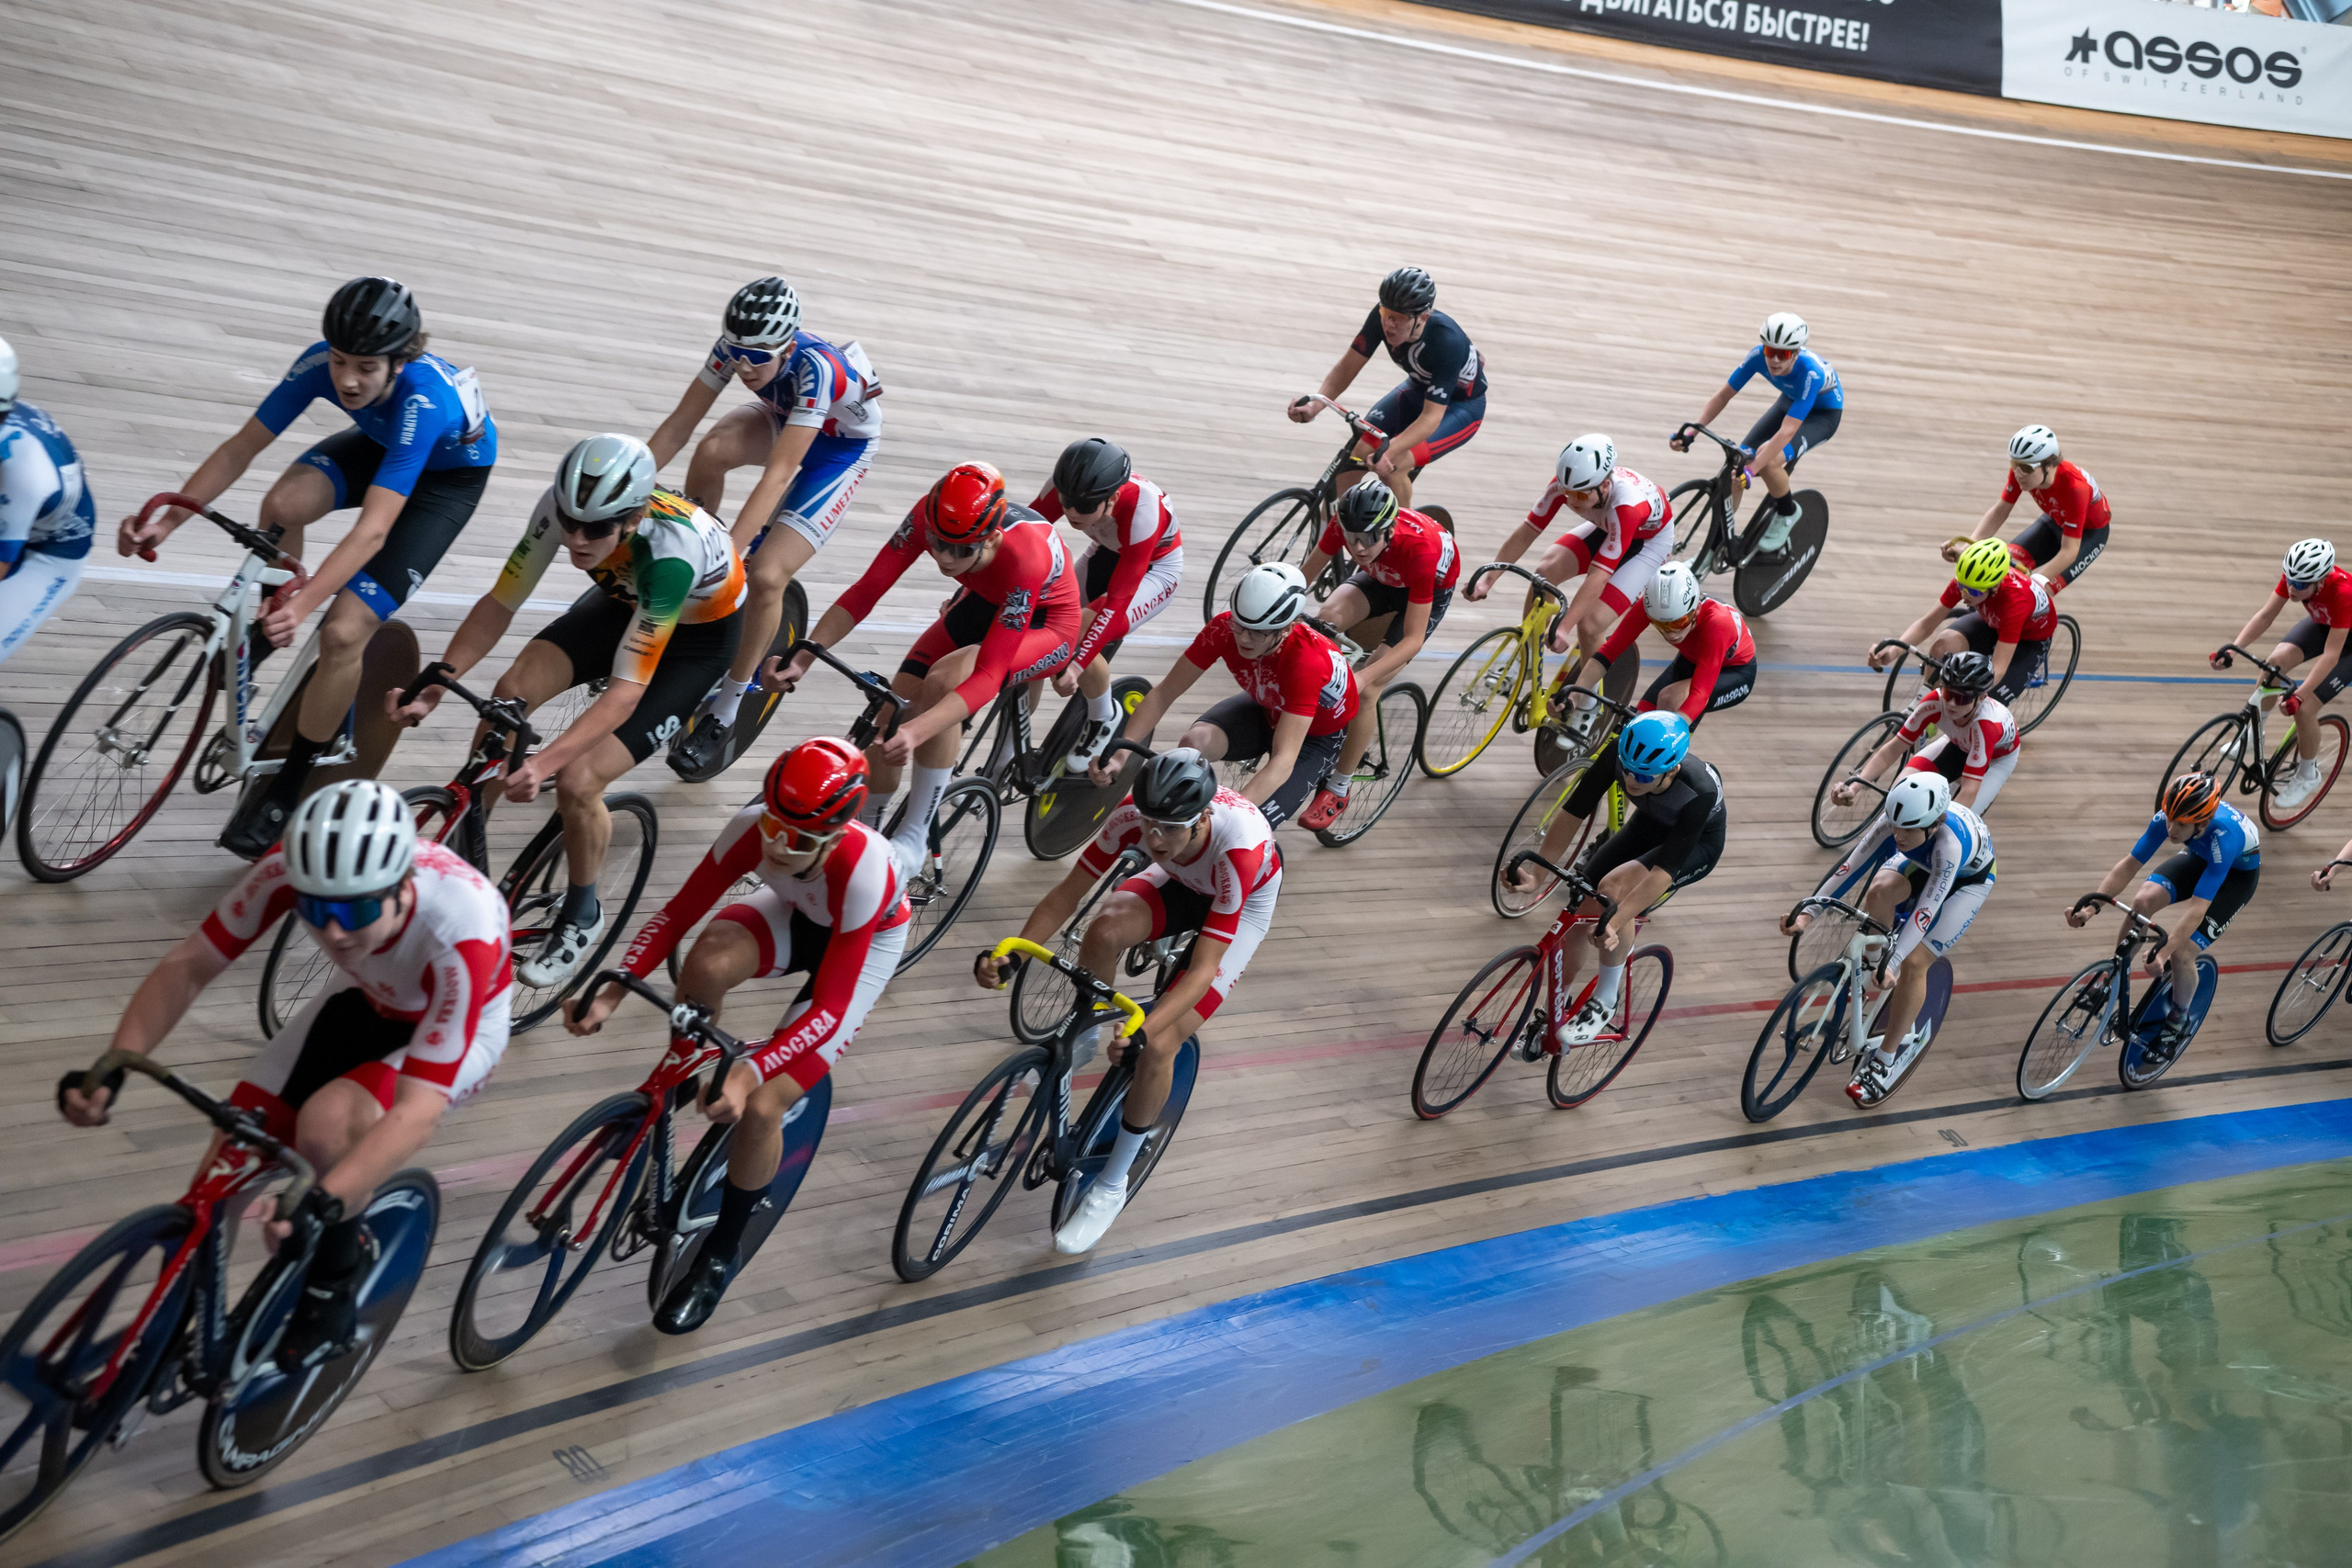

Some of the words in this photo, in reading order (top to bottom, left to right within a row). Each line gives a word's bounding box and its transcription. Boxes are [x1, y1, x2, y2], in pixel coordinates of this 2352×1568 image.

[1744, 4, 1871, 51] БЫСТРЕЕ!
[2103, 30, 2302, 89] assos
[2103, 72, 2303, 106] SWITZERLAND
[1321, 458, 1341, 483] BMC
[1602, 444, 1613, 472] KASK
[1724, 495, 1735, 540] BMC
[2069, 543, 2106, 579] МОСКВА
[1078, 608, 1114, 660] МОСКВА
[1017, 692, 1031, 754] BMC
[1218, 861, 1233, 897] МОСКВА
[1934, 860, 1955, 905] Apidra
[763, 1009, 837, 1073] МОСКВА
[1057, 1010, 1077, 1038] BMC
[1058, 1066, 1072, 1137] BMC
[1937, 1129, 1969, 1147] 90
[932, 1187, 971, 1262] CORIMA
